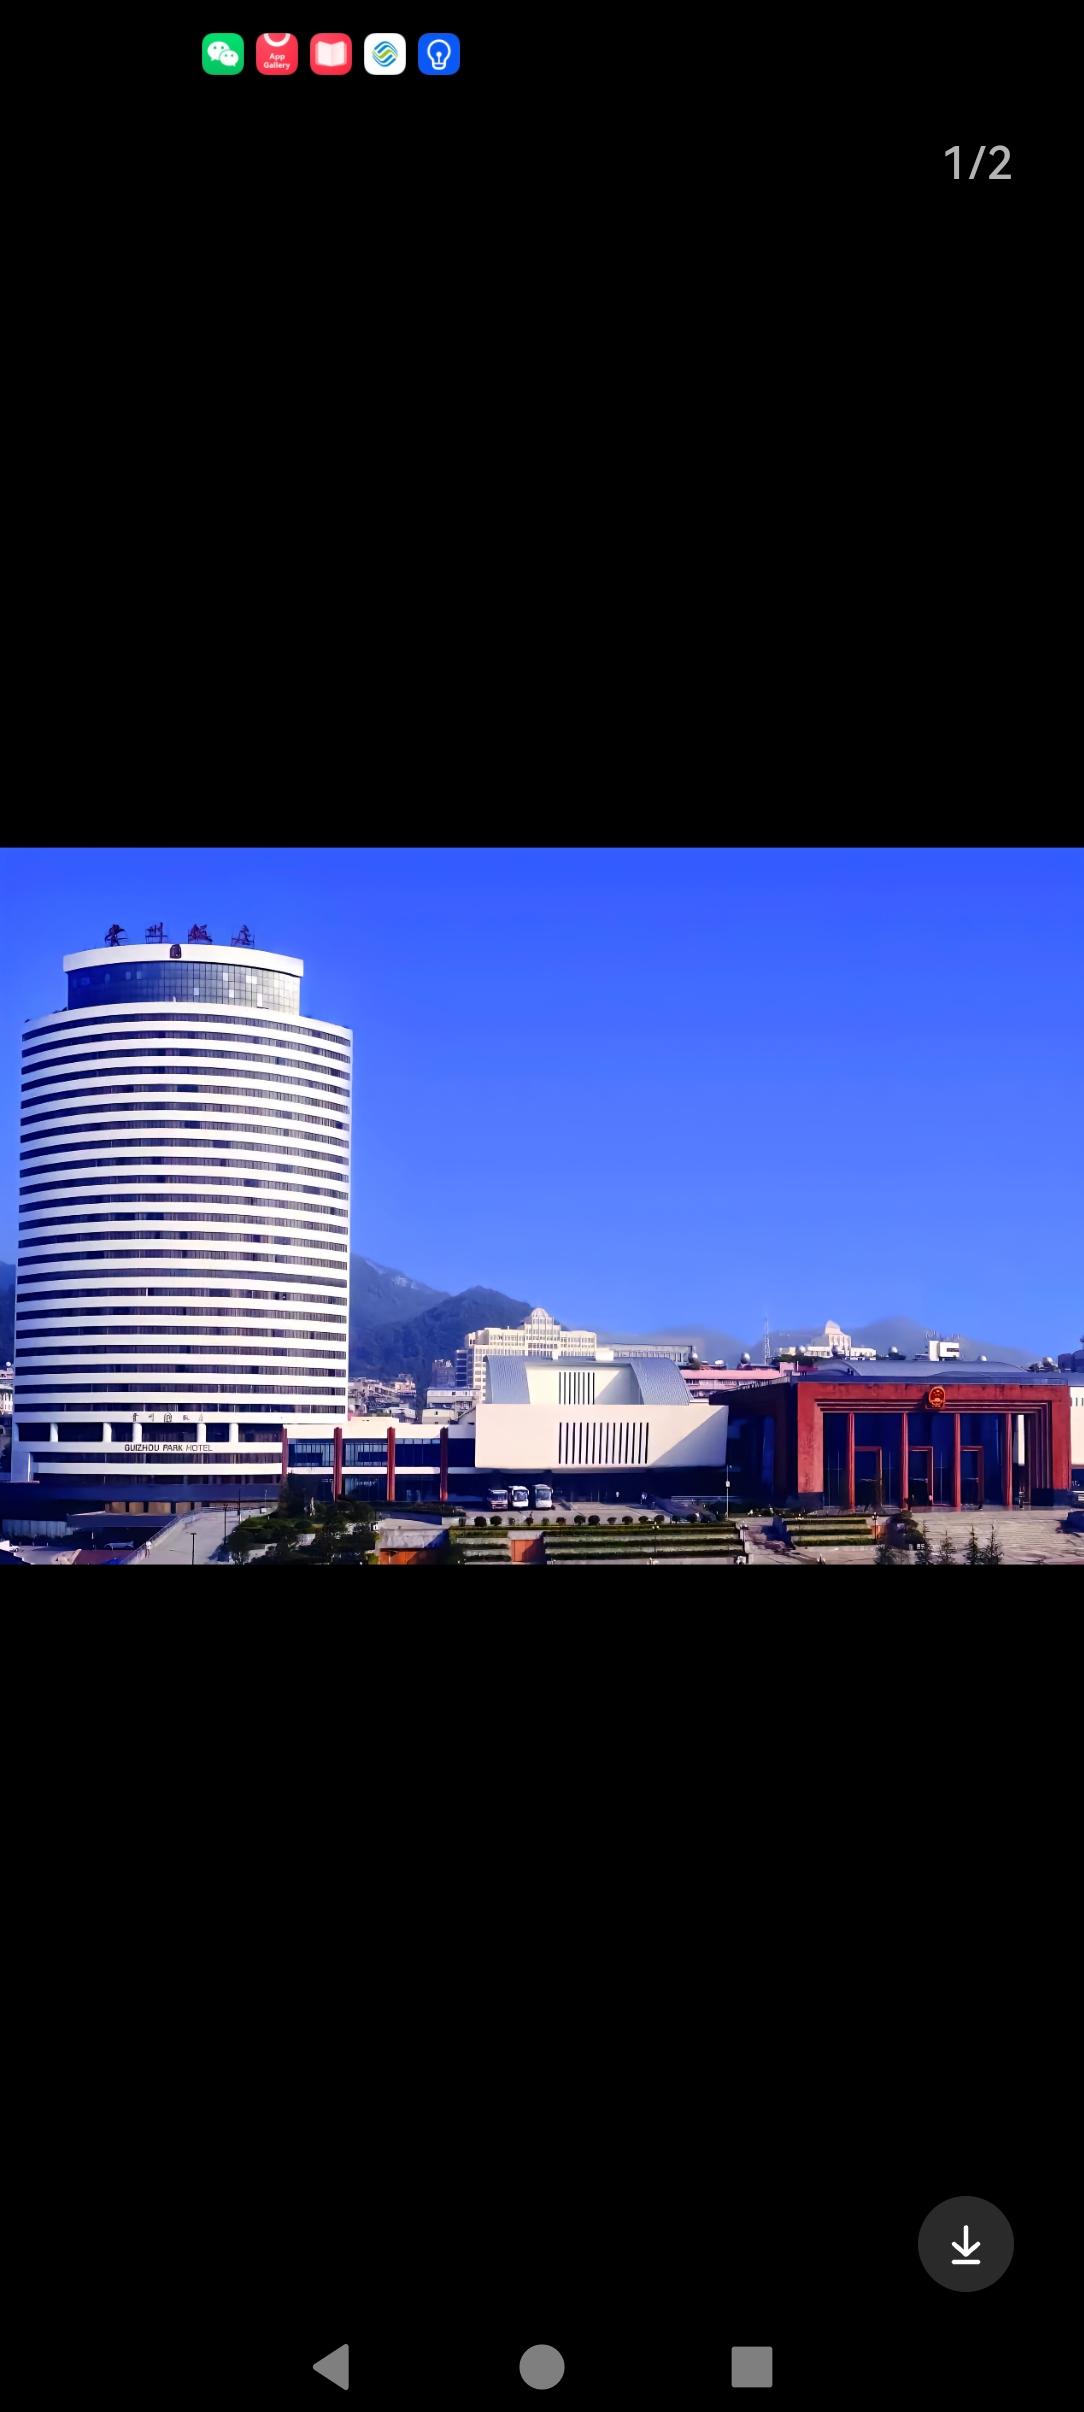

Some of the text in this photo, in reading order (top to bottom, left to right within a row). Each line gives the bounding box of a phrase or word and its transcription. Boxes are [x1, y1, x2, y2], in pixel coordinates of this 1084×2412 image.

[124, 1444, 213, 1452] GUIZHOU PARK HOTEL
